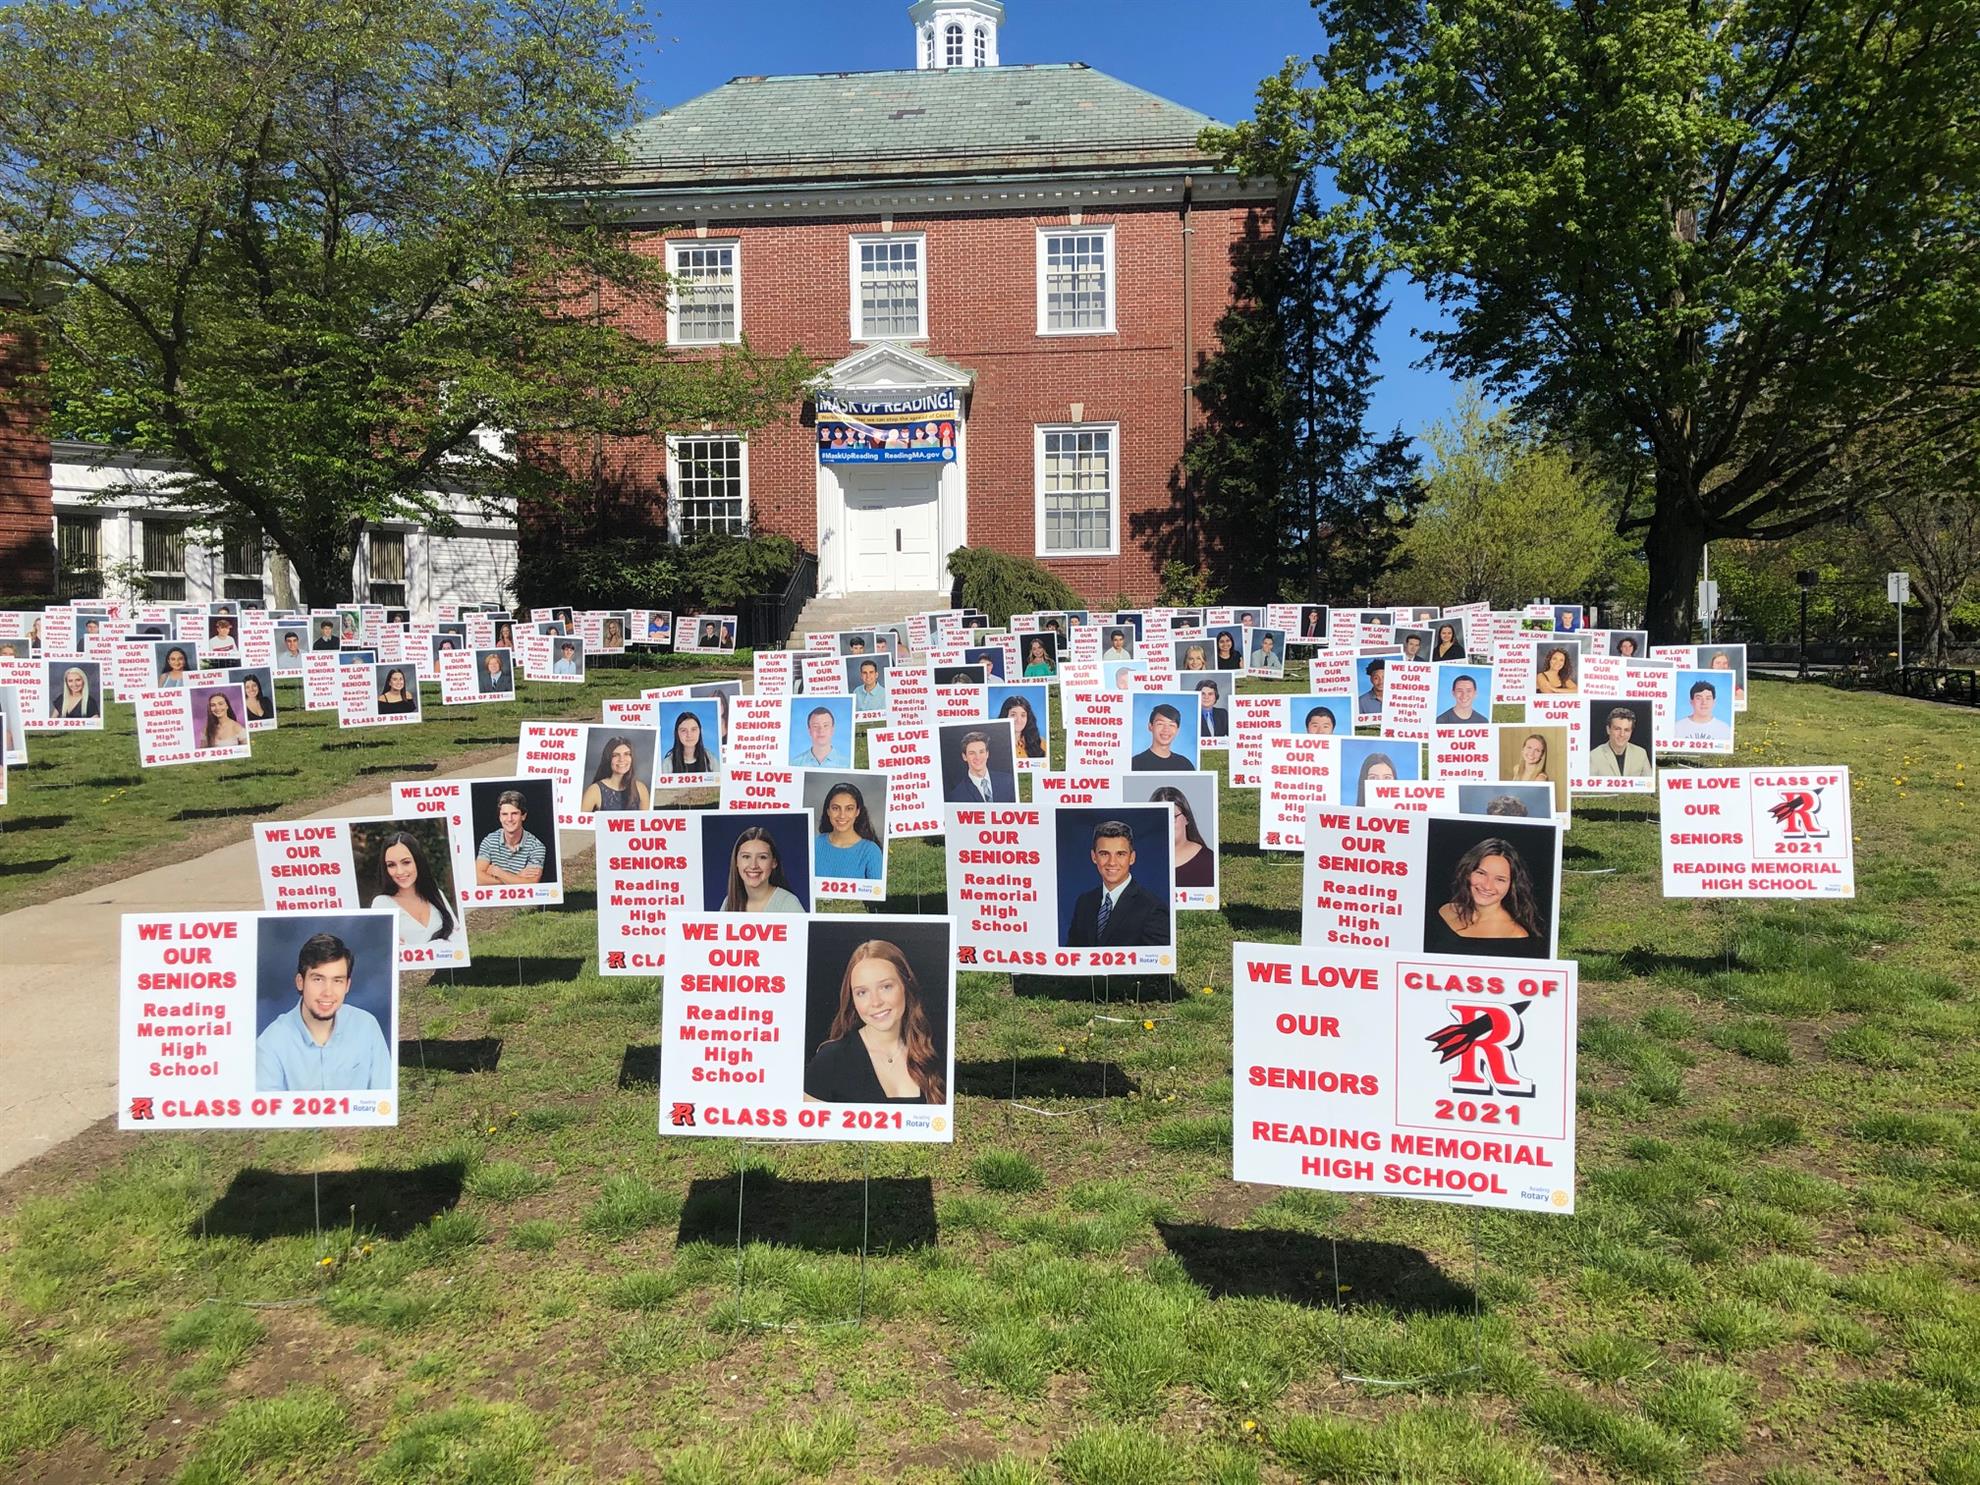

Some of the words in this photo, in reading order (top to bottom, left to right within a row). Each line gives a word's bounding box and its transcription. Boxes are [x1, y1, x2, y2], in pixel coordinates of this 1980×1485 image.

[1391, 683, 1430, 691] SENIORS
[1075, 694, 1091, 702] WE
[1095, 694, 1123, 702] LOVE
[144, 708, 184, 717] SENIORS
[1087, 706, 1111, 714] OUR
[1075, 717, 1123, 725] SENIORS
[159, 753, 191, 761] CLASS
[194, 750, 207, 759] OF
[731, 771, 752, 781] WE
[756, 772, 792, 783] LOVE
[1667, 779, 1692, 789] WE
[1698, 778, 1740, 789] LOVE
[1754, 777, 1809, 786] CLASS
[1817, 776, 1837, 785] OF
[401, 788, 421, 798] WE
[425, 786, 459, 797] LOVE
[746, 786, 775, 797] OUR
[417, 802, 445, 812] OUR
[730, 800, 790, 809] SENIORS
[1685, 804, 1720, 815] OUR
[957, 811, 985, 824] WE
[991, 811, 1039, 824] LOVE
[1319, 814, 1350, 829] WE
[1357, 817, 1409, 834] LOVE
[608, 819, 635, 832] WE
[641, 819, 686, 831] LOVE
[265, 830, 290, 842] WE
[295, 827, 336, 840] LOVE
[979, 831, 1019, 844] OUR
[1671, 833, 1743, 844] SENIORS
[629, 838, 667, 851] OUR
[1342, 837, 1385, 853] OUR
[1775, 842, 1822, 853] 2021
[286, 846, 321, 859] OUR
[959, 850, 1040, 864] SENIORS
[271, 863, 341, 877] SENIORS
[610, 857, 687, 870] SENIORS
[1318, 855, 1408, 876] SENIORS
[1674, 863, 1745, 873] READING
[1752, 863, 1841, 873] MEMORIAL
[615, 880, 679, 892] Reading
[822, 881, 856, 893] 2021
[965, 874, 1031, 888] Reading
[1702, 879, 1742, 889] HIGH
[1749, 879, 1817, 890] SCHOOL
[279, 885, 336, 896] Reading
[475, 890, 493, 900] OF
[500, 888, 533, 899] 2021
[961, 889, 1037, 901] Memorial
[1323, 880, 1398, 900] Reading
[276, 898, 342, 910] Memorial
[611, 895, 684, 905] Memorial
[1318, 895, 1403, 916] Memorial
[981, 905, 1017, 919] High
[972, 920, 1027, 932] School
[1339, 915, 1379, 931] High
[138, 924, 172, 940] WE
[180, 922, 237, 939] LOVE
[682, 923, 718, 940] WE
[726, 924, 787, 941] LOVE
[1328, 930, 1389, 947] School
[164, 948, 211, 964] OUR
[709, 949, 760, 966] OUR
[983, 950, 1047, 965] CLASS
[1055, 953, 1081, 966] OF
[1090, 952, 1136, 966] 2021
[138, 972, 236, 990] SENIORS
[1247, 962, 1291, 984] WE
[1302, 965, 1378, 990] LOVE
[681, 975, 785, 993] SENIORS
[1405, 973, 1504, 994] CLASS
[1518, 979, 1558, 997] OF
[144, 1003, 225, 1019] Reading
[687, 1005, 774, 1023] Reading
[138, 1022, 231, 1037] Memorial
[1276, 1014, 1340, 1037] OUR
[680, 1025, 780, 1042] Memorial
[162, 1042, 206, 1059] High
[1446, 999, 1536, 1098] R
[705, 1047, 752, 1065] High
[150, 1062, 218, 1076] School
[692, 1067, 764, 1083] School
[1249, 1066, 1378, 1095] SENIORS
[162, 1099, 241, 1117] CLASS
[252, 1099, 282, 1115] OF
[293, 1098, 349, 1115] 2021
[1435, 1100, 1519, 1125] 2021
[704, 1107, 787, 1126] CLASS
[798, 1110, 831, 1127] OF
[842, 1111, 901, 1129] 2021
[906, 1120, 930, 1128] Rotary
[1253, 1121, 1380, 1151] READING
[1391, 1134, 1553, 1167] MEMORIAL
[1302, 1156, 1373, 1180] HIGH
[1383, 1164, 1507, 1194] SCHOOL
[1521, 1191, 1549, 1201] Rotary
